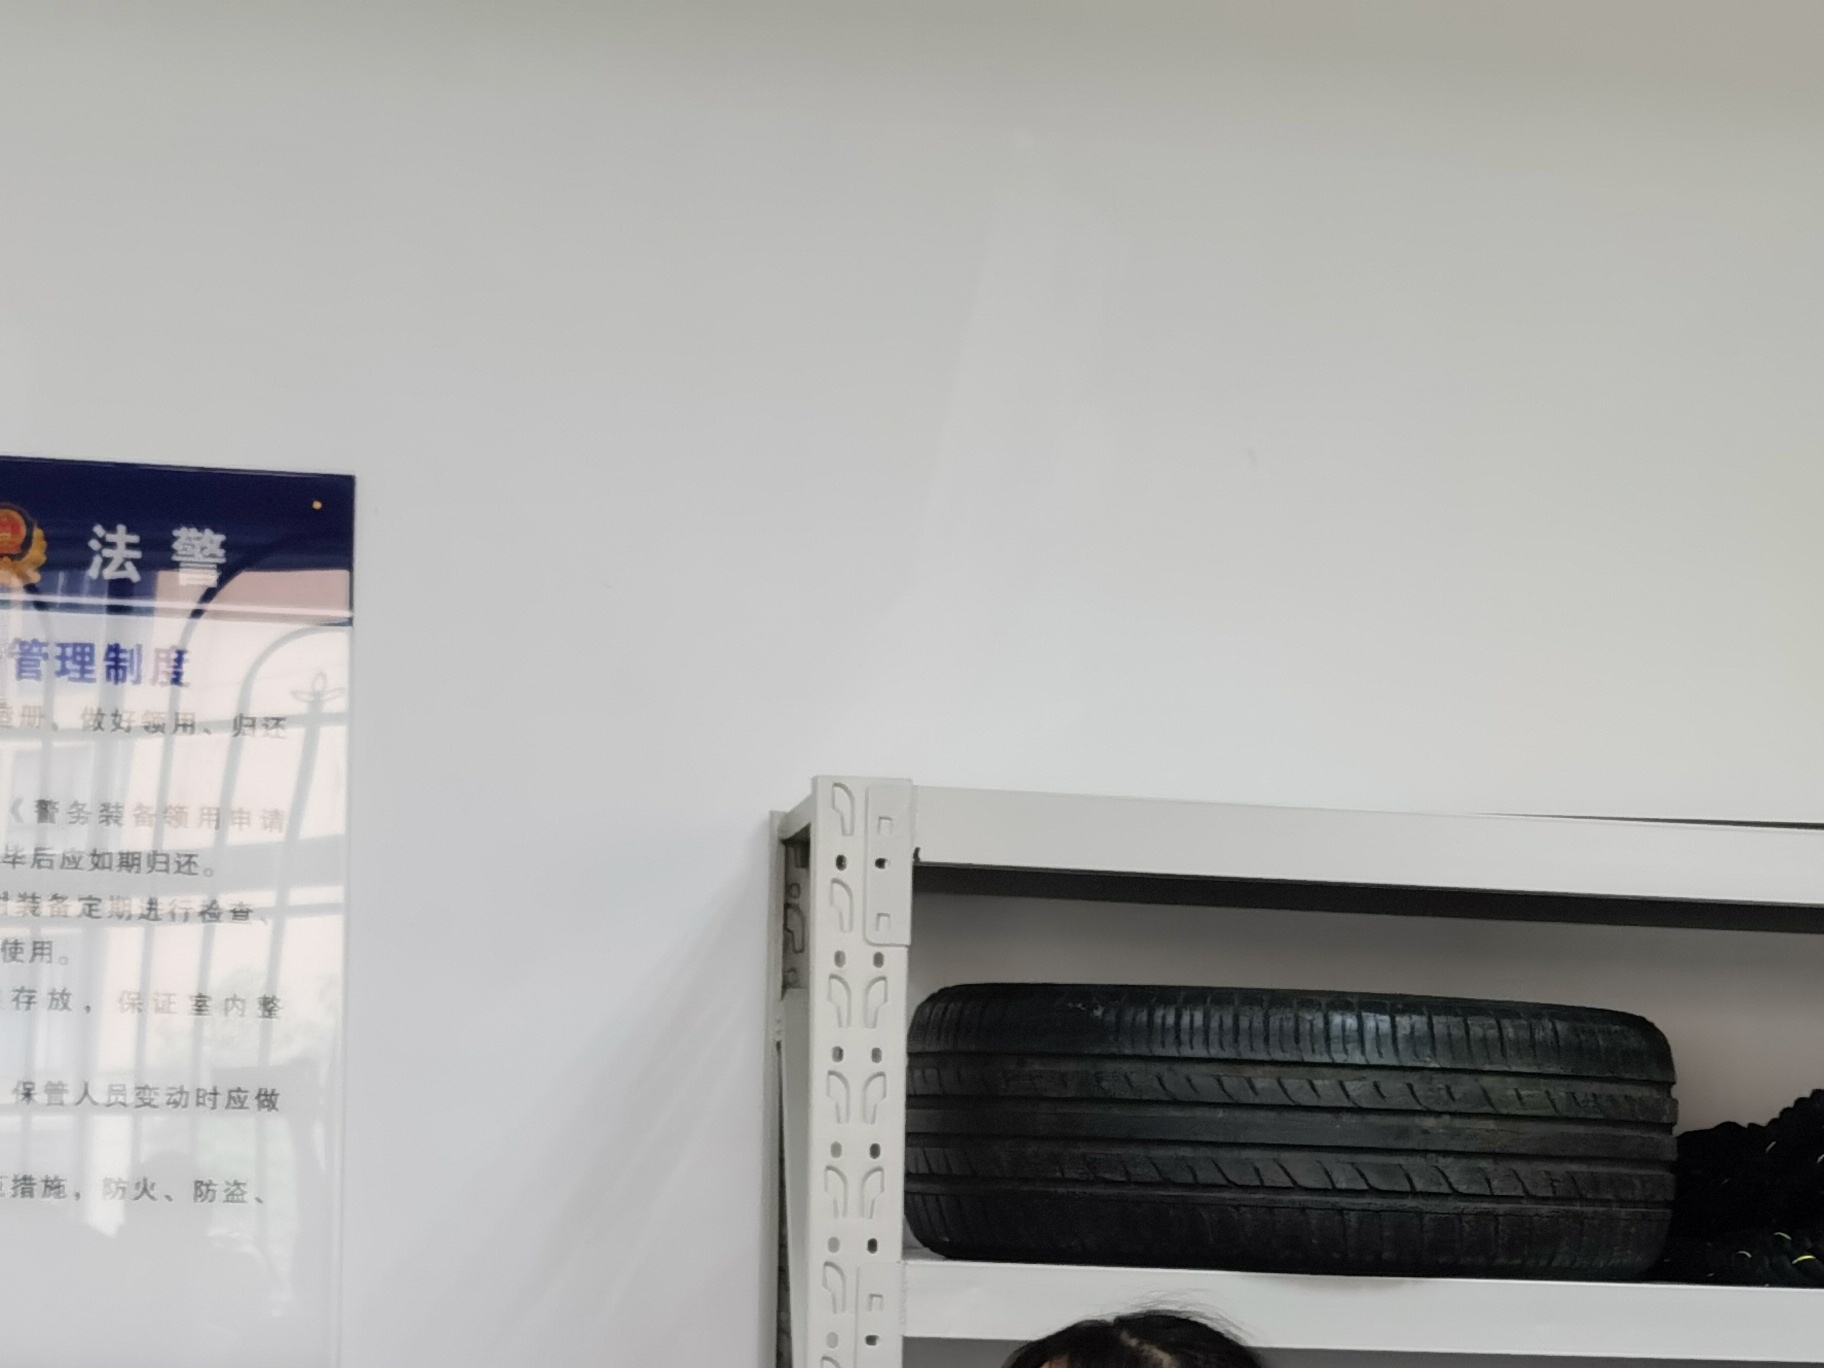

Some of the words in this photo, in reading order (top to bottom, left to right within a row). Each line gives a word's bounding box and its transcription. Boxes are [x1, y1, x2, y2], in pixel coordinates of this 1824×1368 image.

[88, 524, 227, 588] 法警
[14, 637, 190, 687] 管理制度
[1, 938, 69, 967] 使用。
[12, 1080, 280, 1112] 保管人员变动时应做
